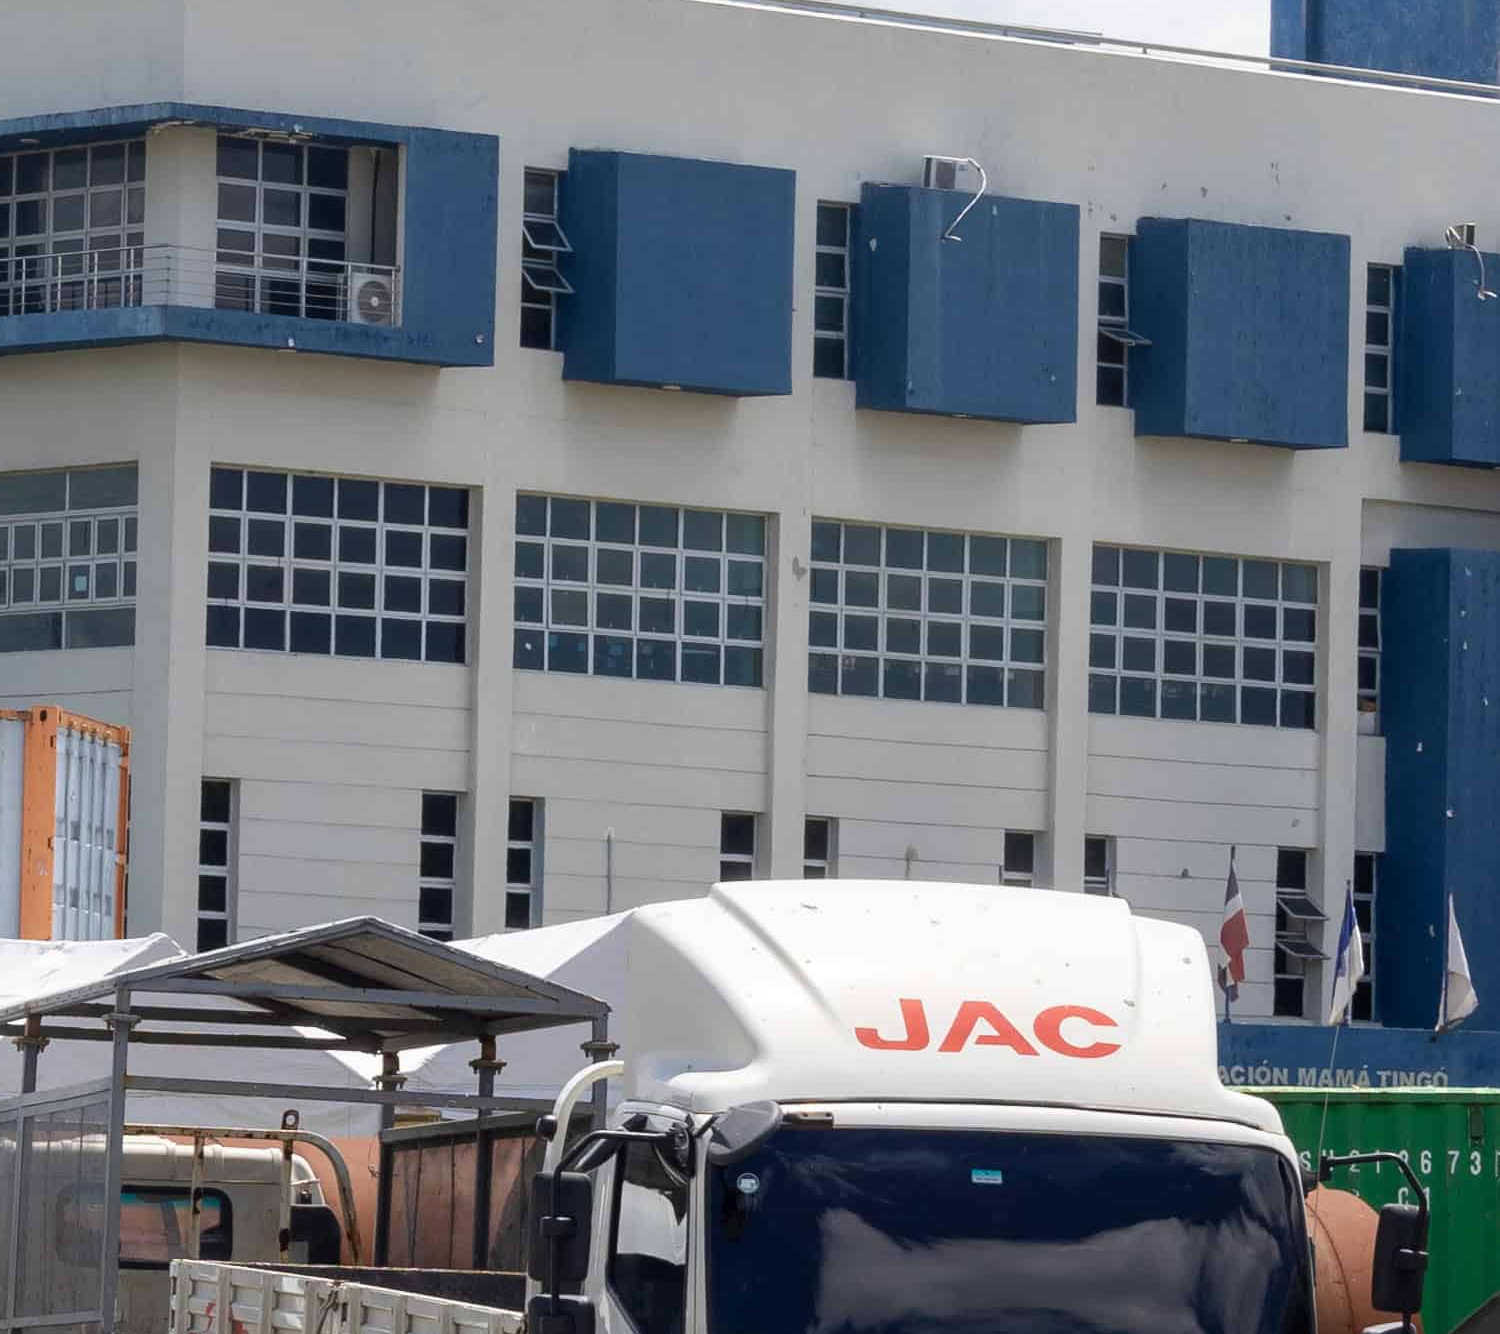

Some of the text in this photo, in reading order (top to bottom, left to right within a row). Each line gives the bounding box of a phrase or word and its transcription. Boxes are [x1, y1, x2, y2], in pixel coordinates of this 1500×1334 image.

[854, 998, 1122, 1059] JAC
[1299, 1064, 1371, 1087] MAMÁ
[1376, 1067, 1449, 1088] TINGÓ
